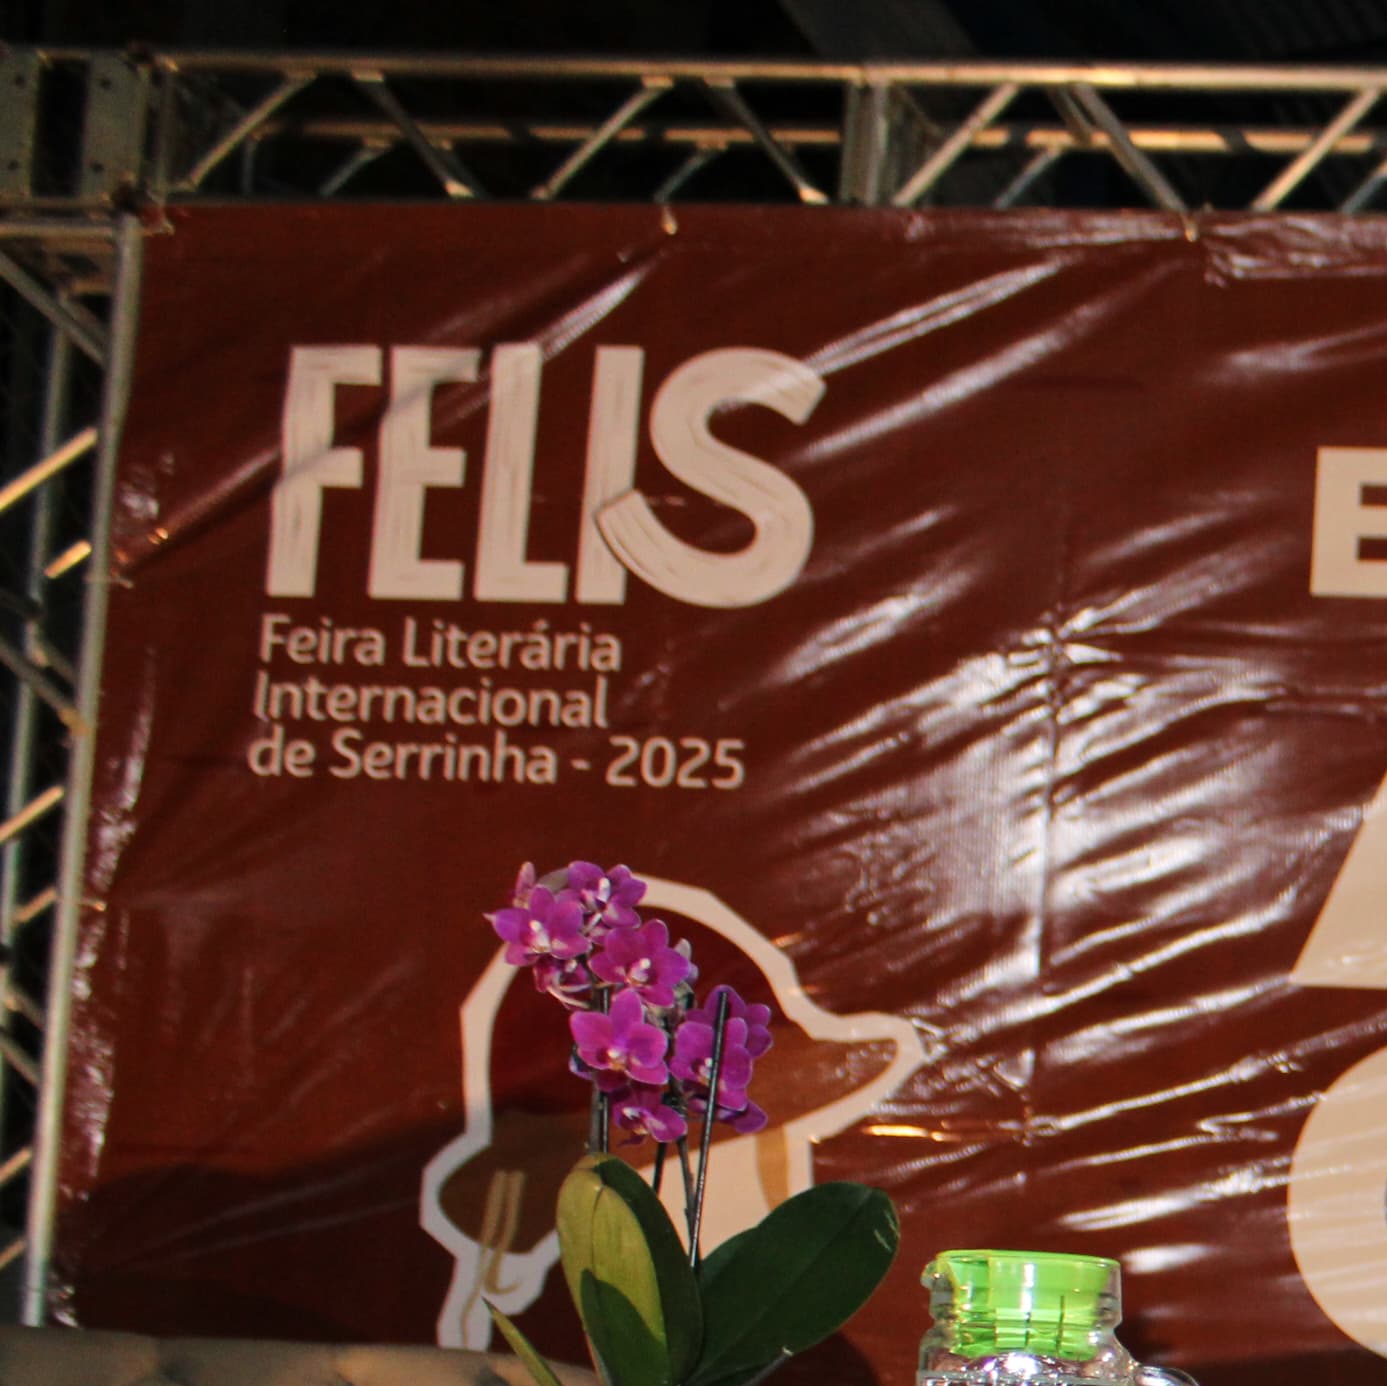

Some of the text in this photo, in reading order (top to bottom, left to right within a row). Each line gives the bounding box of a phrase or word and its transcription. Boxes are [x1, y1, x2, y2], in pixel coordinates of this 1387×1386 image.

[267, 344, 827, 608] FELIS
[259, 613, 621, 672] Feira Literária
[253, 671, 609, 729] Internacional
[248, 726, 316, 776] de
[330, 728, 558, 784] Serrinha
[606, 736, 746, 789] 2025
